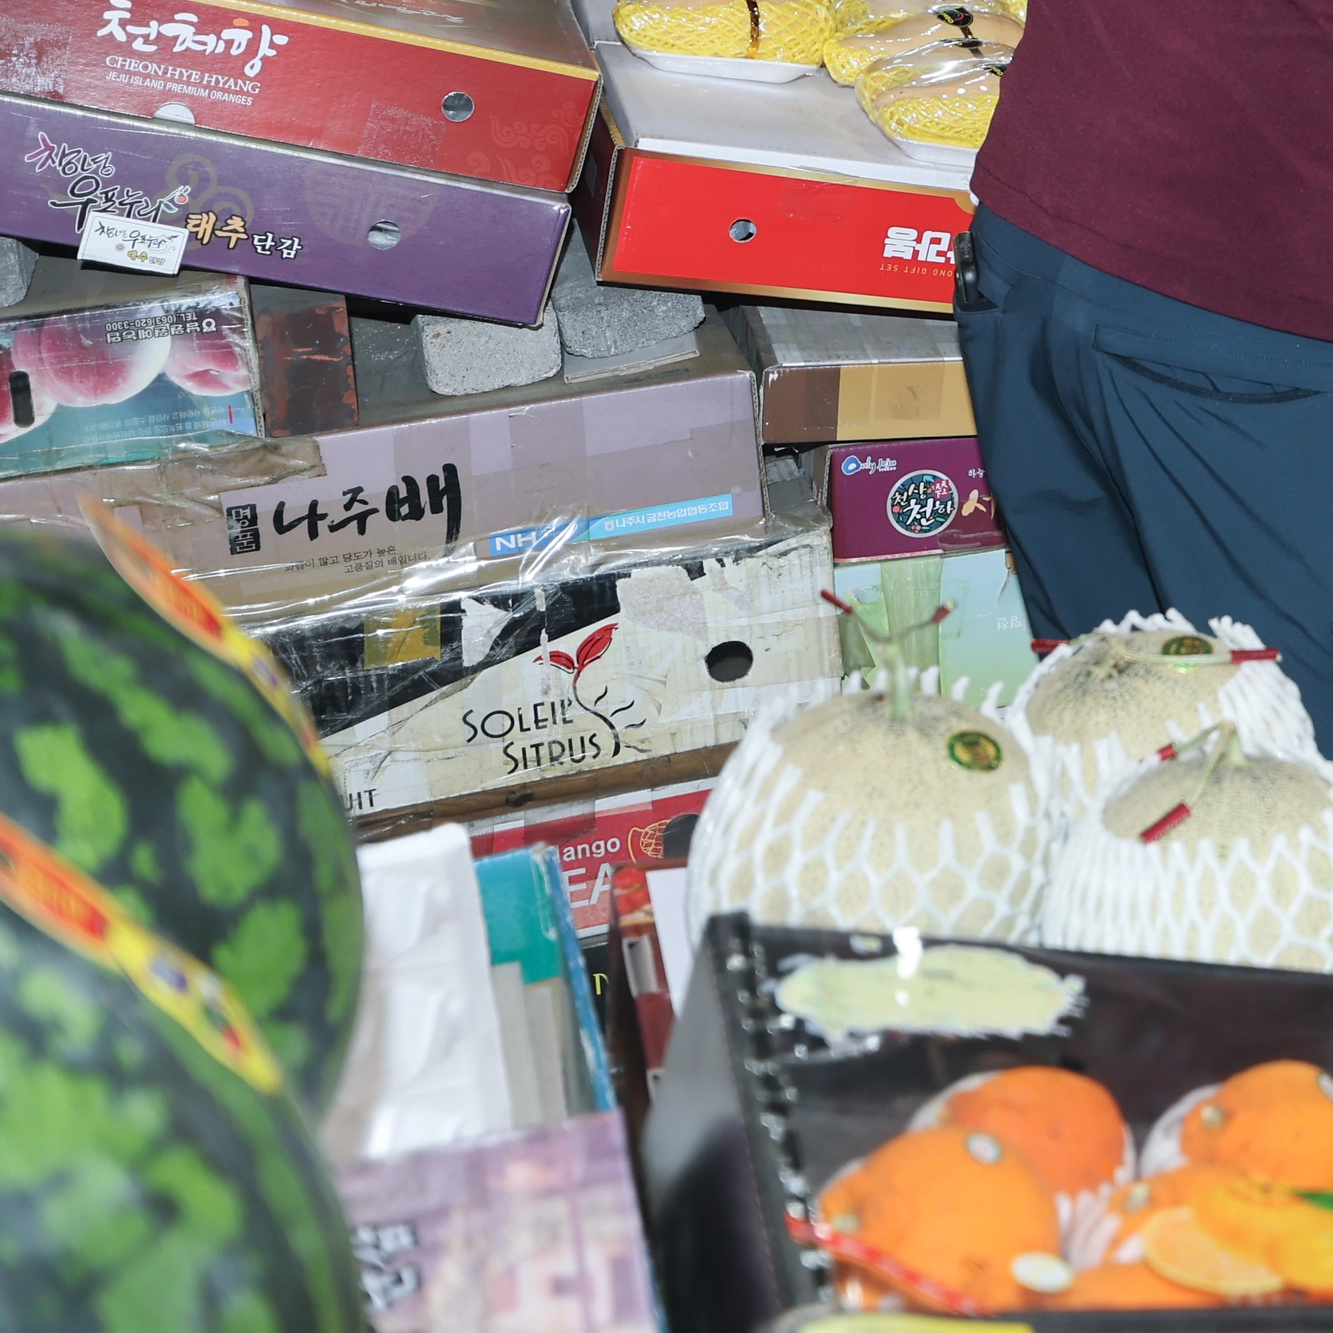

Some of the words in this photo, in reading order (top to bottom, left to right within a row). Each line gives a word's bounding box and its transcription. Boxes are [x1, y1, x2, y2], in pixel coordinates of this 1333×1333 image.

[106, 55, 165, 77] CHEON
[166, 67, 201, 83] HYE
[202, 74, 261, 94] HYANG
[106, 71, 130, 82] JEJU
[130, 75, 165, 90] ISLAND
[166, 83, 209, 99] PREMIUM
[210, 90, 253, 106] ORANGES
[25, 132, 115, 177] 창녕
[185, 211, 249, 249] 태추
[251, 232, 303, 259] 단감
[879, 263, 899, 272] SET
[904, 266, 927, 275] GIFT
[933, 269, 952, 277] ONG
[106, 322, 200, 344] 남원원예농협
[841, 455, 876, 475] Only
[273, 463, 461, 558] 나주배
[615, 515, 646, 529] 나주시
[647, 501, 729, 523] 금천농업협동조합
[495, 531, 537, 551] NH
[319, 554, 339, 565] 많고
[342, 548, 373, 563] 당도가
[376, 545, 397, 558] 높은
[344, 559, 384, 574] 고품질의
[503, 733, 601, 774] SITRUS
[346, 788, 377, 812] UIT
